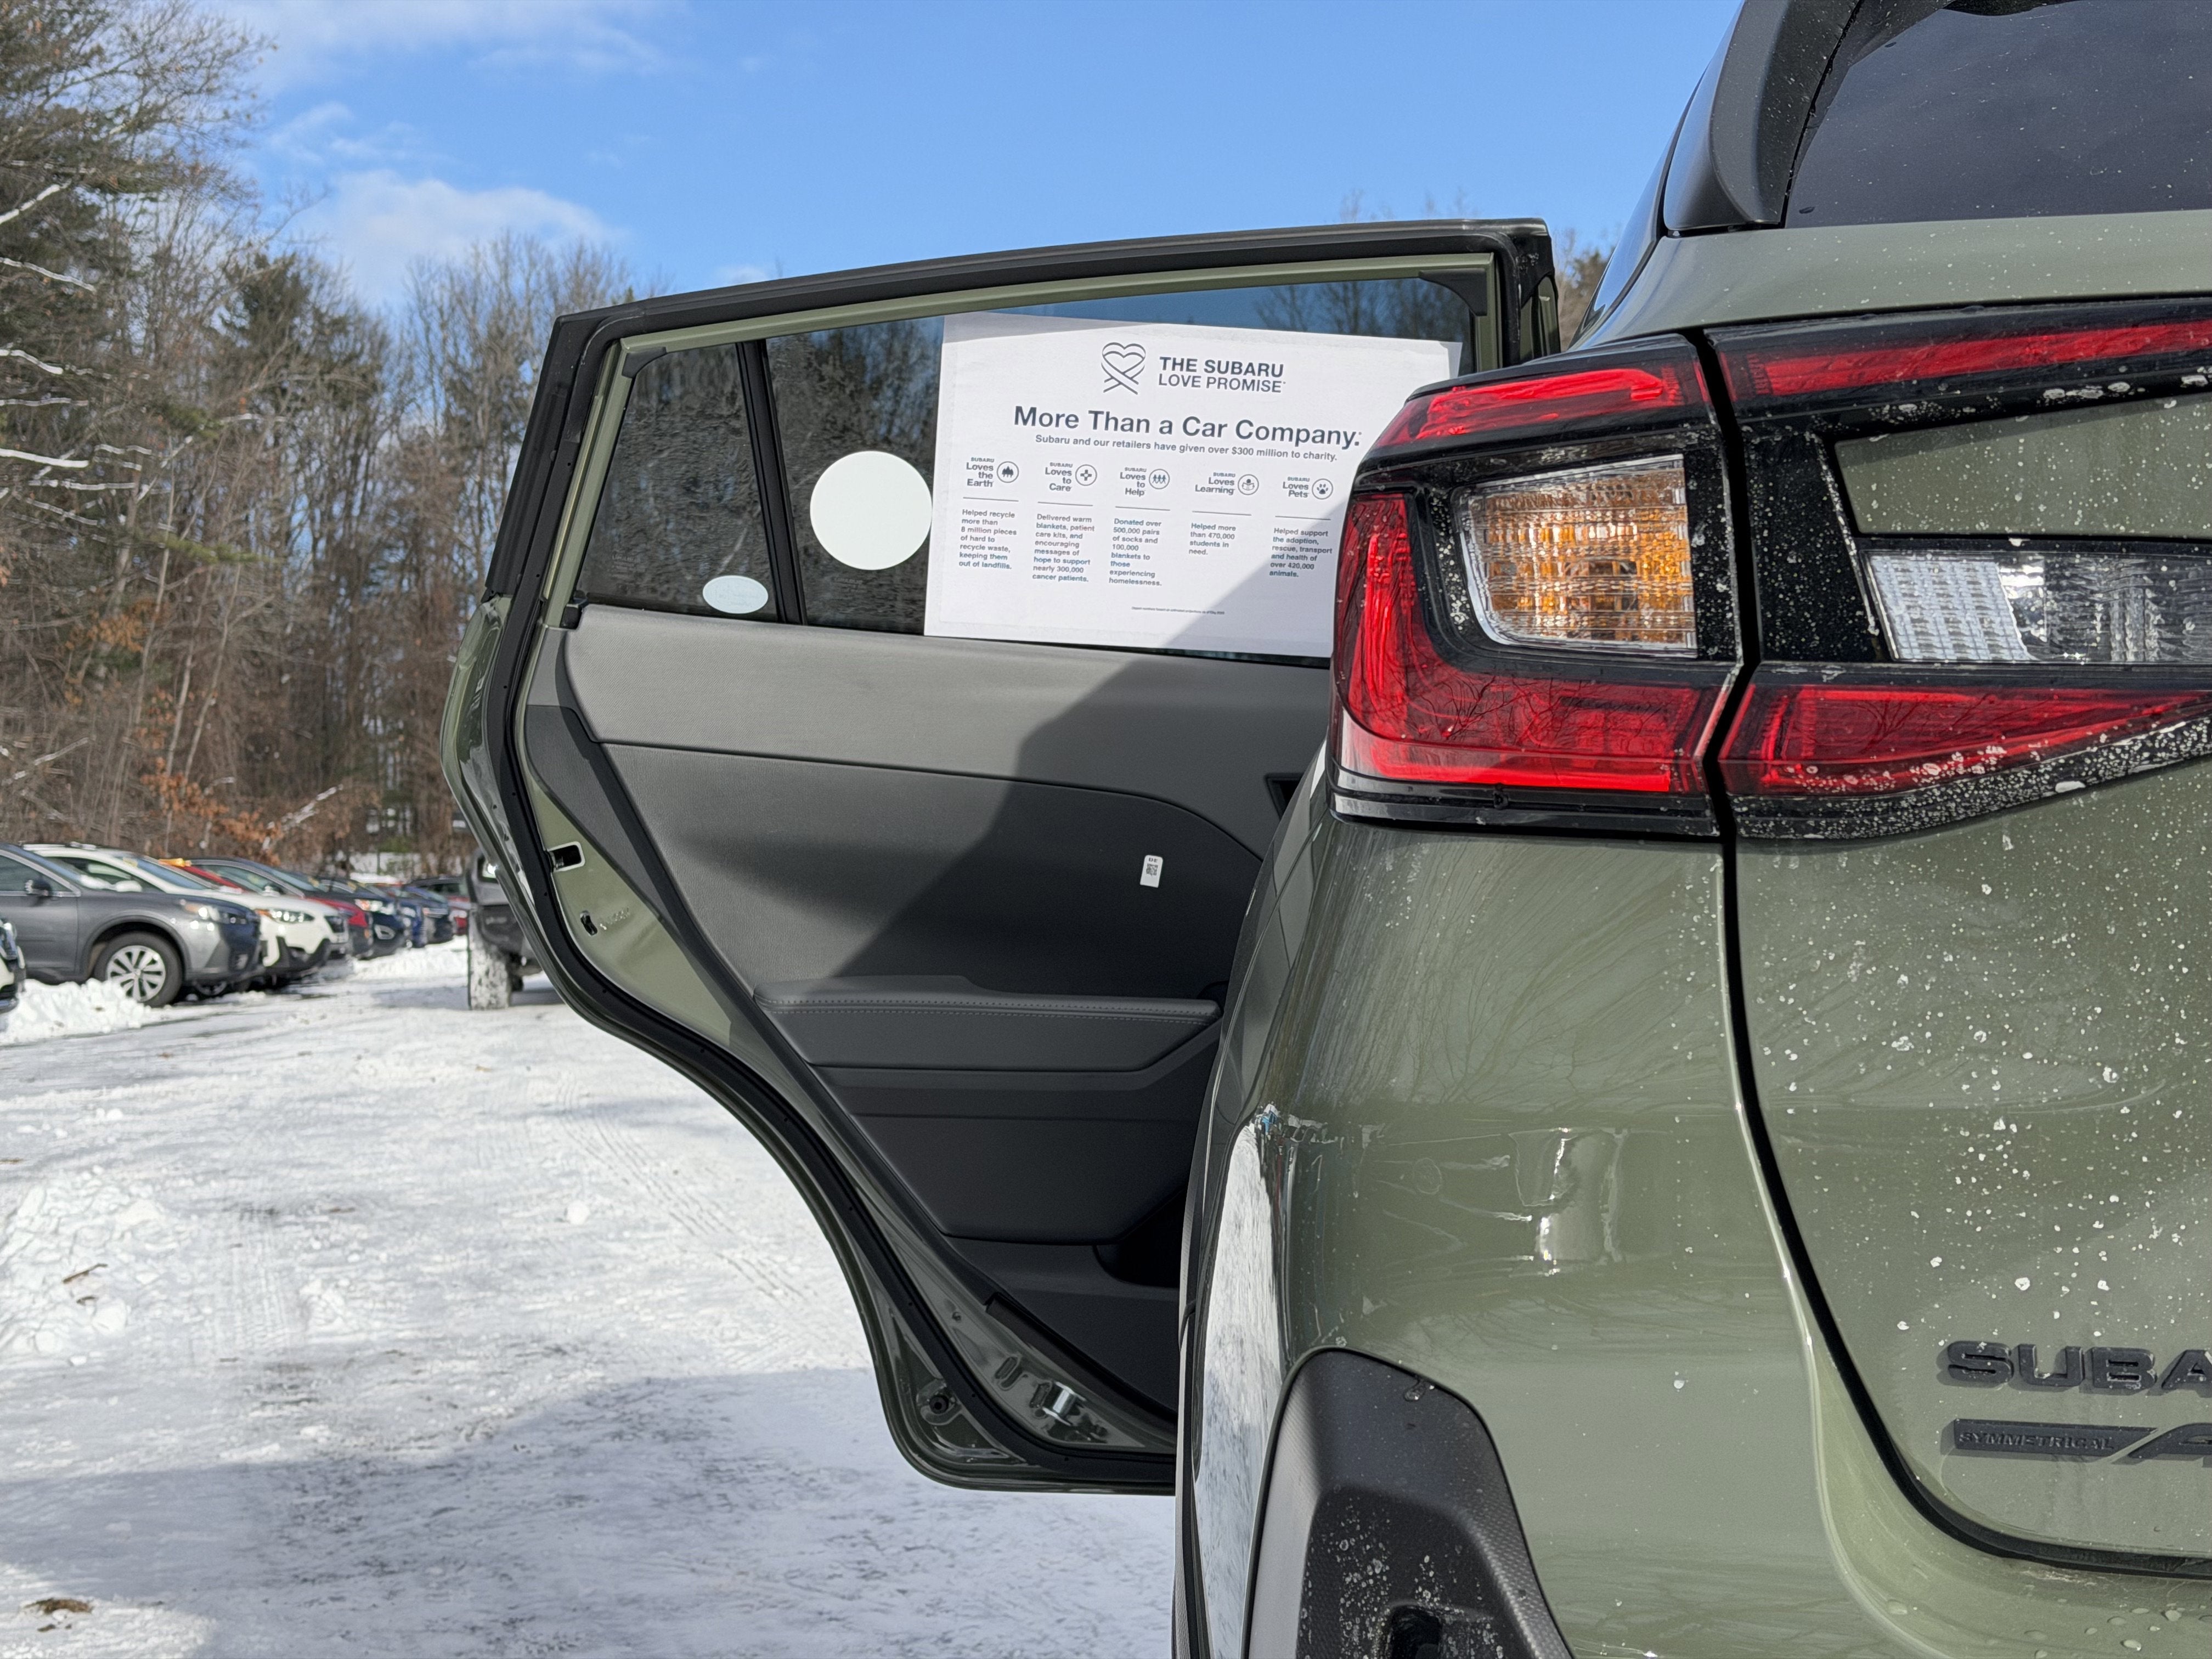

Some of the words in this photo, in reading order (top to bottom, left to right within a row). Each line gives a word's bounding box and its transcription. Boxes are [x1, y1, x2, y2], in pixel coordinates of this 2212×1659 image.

[1160, 357, 1198, 372] THE
[1204, 359, 1284, 377] SUBARU
[1159, 374, 1201, 387] LOVE
[1206, 376, 1282, 393] PROMISE
[1015, 406, 1079, 428] More
[1088, 410, 1150, 433] Than
[1159, 420, 1172, 435] a
[1183, 416, 1227, 437] Car
[1235, 420, 1360, 450] Company.
[1036, 435, 1070, 444] Subaru
[1113, 441, 1150, 449] retailers
[1154, 442, 1176, 450] have
[1180, 444, 1205, 453] given
[1232, 447, 1254, 455] $300
[1256, 449, 1288, 458] million
[1304, 451, 1336, 462] charity.
[967, 462, 994, 471] Loves
[1045, 467, 1072, 476] Loves
[1120, 472, 1146, 481] Loves
[967, 478, 994, 487] Earth
[1209, 477, 1234, 486] Loves
[1283, 481, 1309, 490] Loves
[1049, 483, 1072, 492] Care
[1125, 487, 1146, 497] Help
[1195, 484, 1235, 495] Learning
[1288, 489, 1310, 498] Pets
[962, 509, 988, 517] Helped
[1037, 514, 1071, 522] Delivered
[1191, 523, 1216, 531] Helped
[1035, 540, 1080, 549] encouraging
[1300, 546, 1333, 555] transport
[960, 551, 988, 561] keeping
[1109, 570, 1155, 579] experiencing
[1959, 1431, 2114, 1450] SYMMETRICAL
